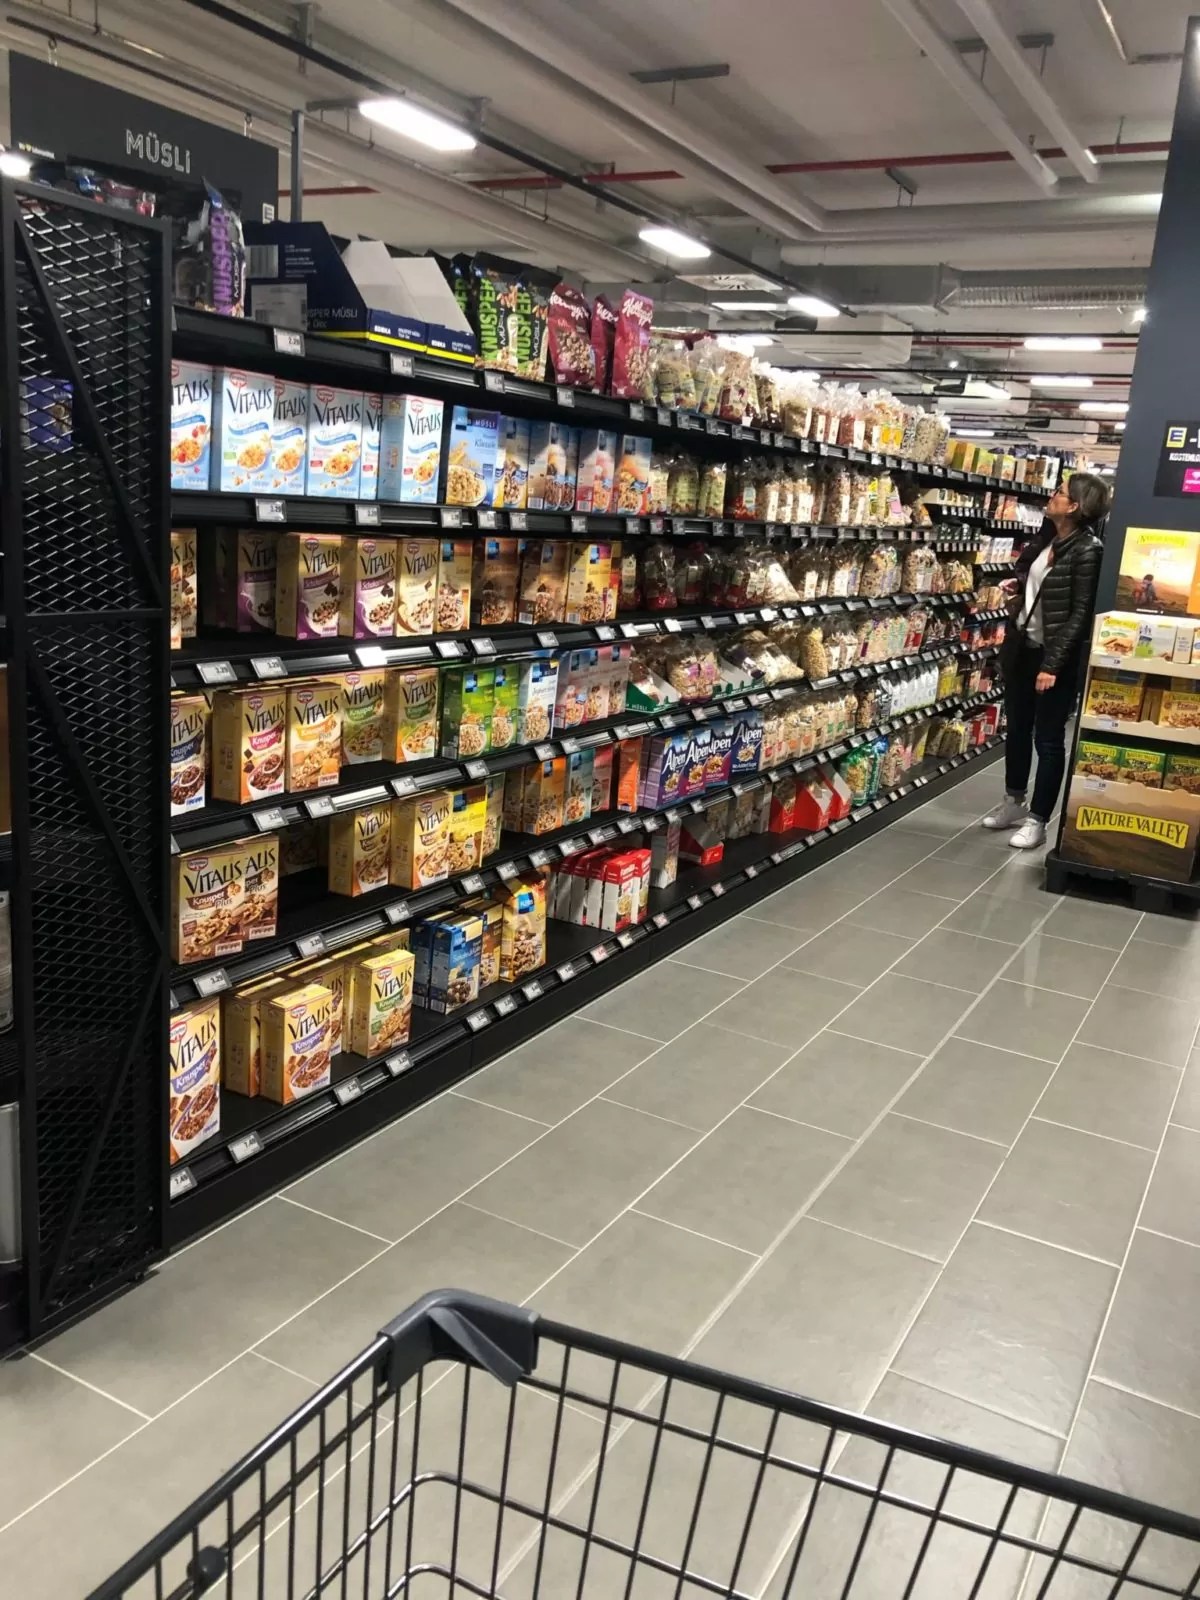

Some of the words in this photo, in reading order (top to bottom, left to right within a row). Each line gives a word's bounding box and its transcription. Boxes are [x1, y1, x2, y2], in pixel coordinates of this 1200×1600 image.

[126, 129, 191, 174] MÜSLI
[332, 306, 358, 319] MÜSLI
[480, 277, 498, 362] KNUSPER
[499, 308, 507, 347] MÜSLI
[533, 320, 541, 359] MÜSLI
[228, 388, 272, 414] VITALIS
[313, 403, 360, 427] VITALIS
[408, 413, 441, 436] VITALIS
[475, 419, 496, 429] MÜSLI
[303, 547, 339, 573] VITALIS
[360, 550, 395, 575] VITALIS
[404, 552, 437, 575] VITALIS
[344, 682, 383, 706] VITALIS
[401, 678, 436, 704] VITALIS
[245, 700, 285, 732] VITALIS
[294, 696, 338, 725] VITALIS
[252, 734, 276, 747] Knusper
[708, 738, 731, 754] lpen
[732, 725, 762, 745] Alpen
[664, 750, 686, 775] Alpen
[685, 742, 709, 765] Alpen
[358, 808, 389, 835] VITALIS
[417, 805, 449, 832] VITALIS
[1080, 808, 1134, 828] NATURE
[1136, 817, 1185, 845] VALLEY
[246, 848, 275, 873] ALIS
[183, 860, 242, 894] VITALIS
[192, 892, 225, 905] Knusper
[374, 966, 412, 999] VITALIS
[288, 1003, 331, 1040] VITALIS
[170, 1013, 217, 1073] VITALIS
[295, 1033, 322, 1050] Knusper
[175, 1059, 206, 1091] Knusper
